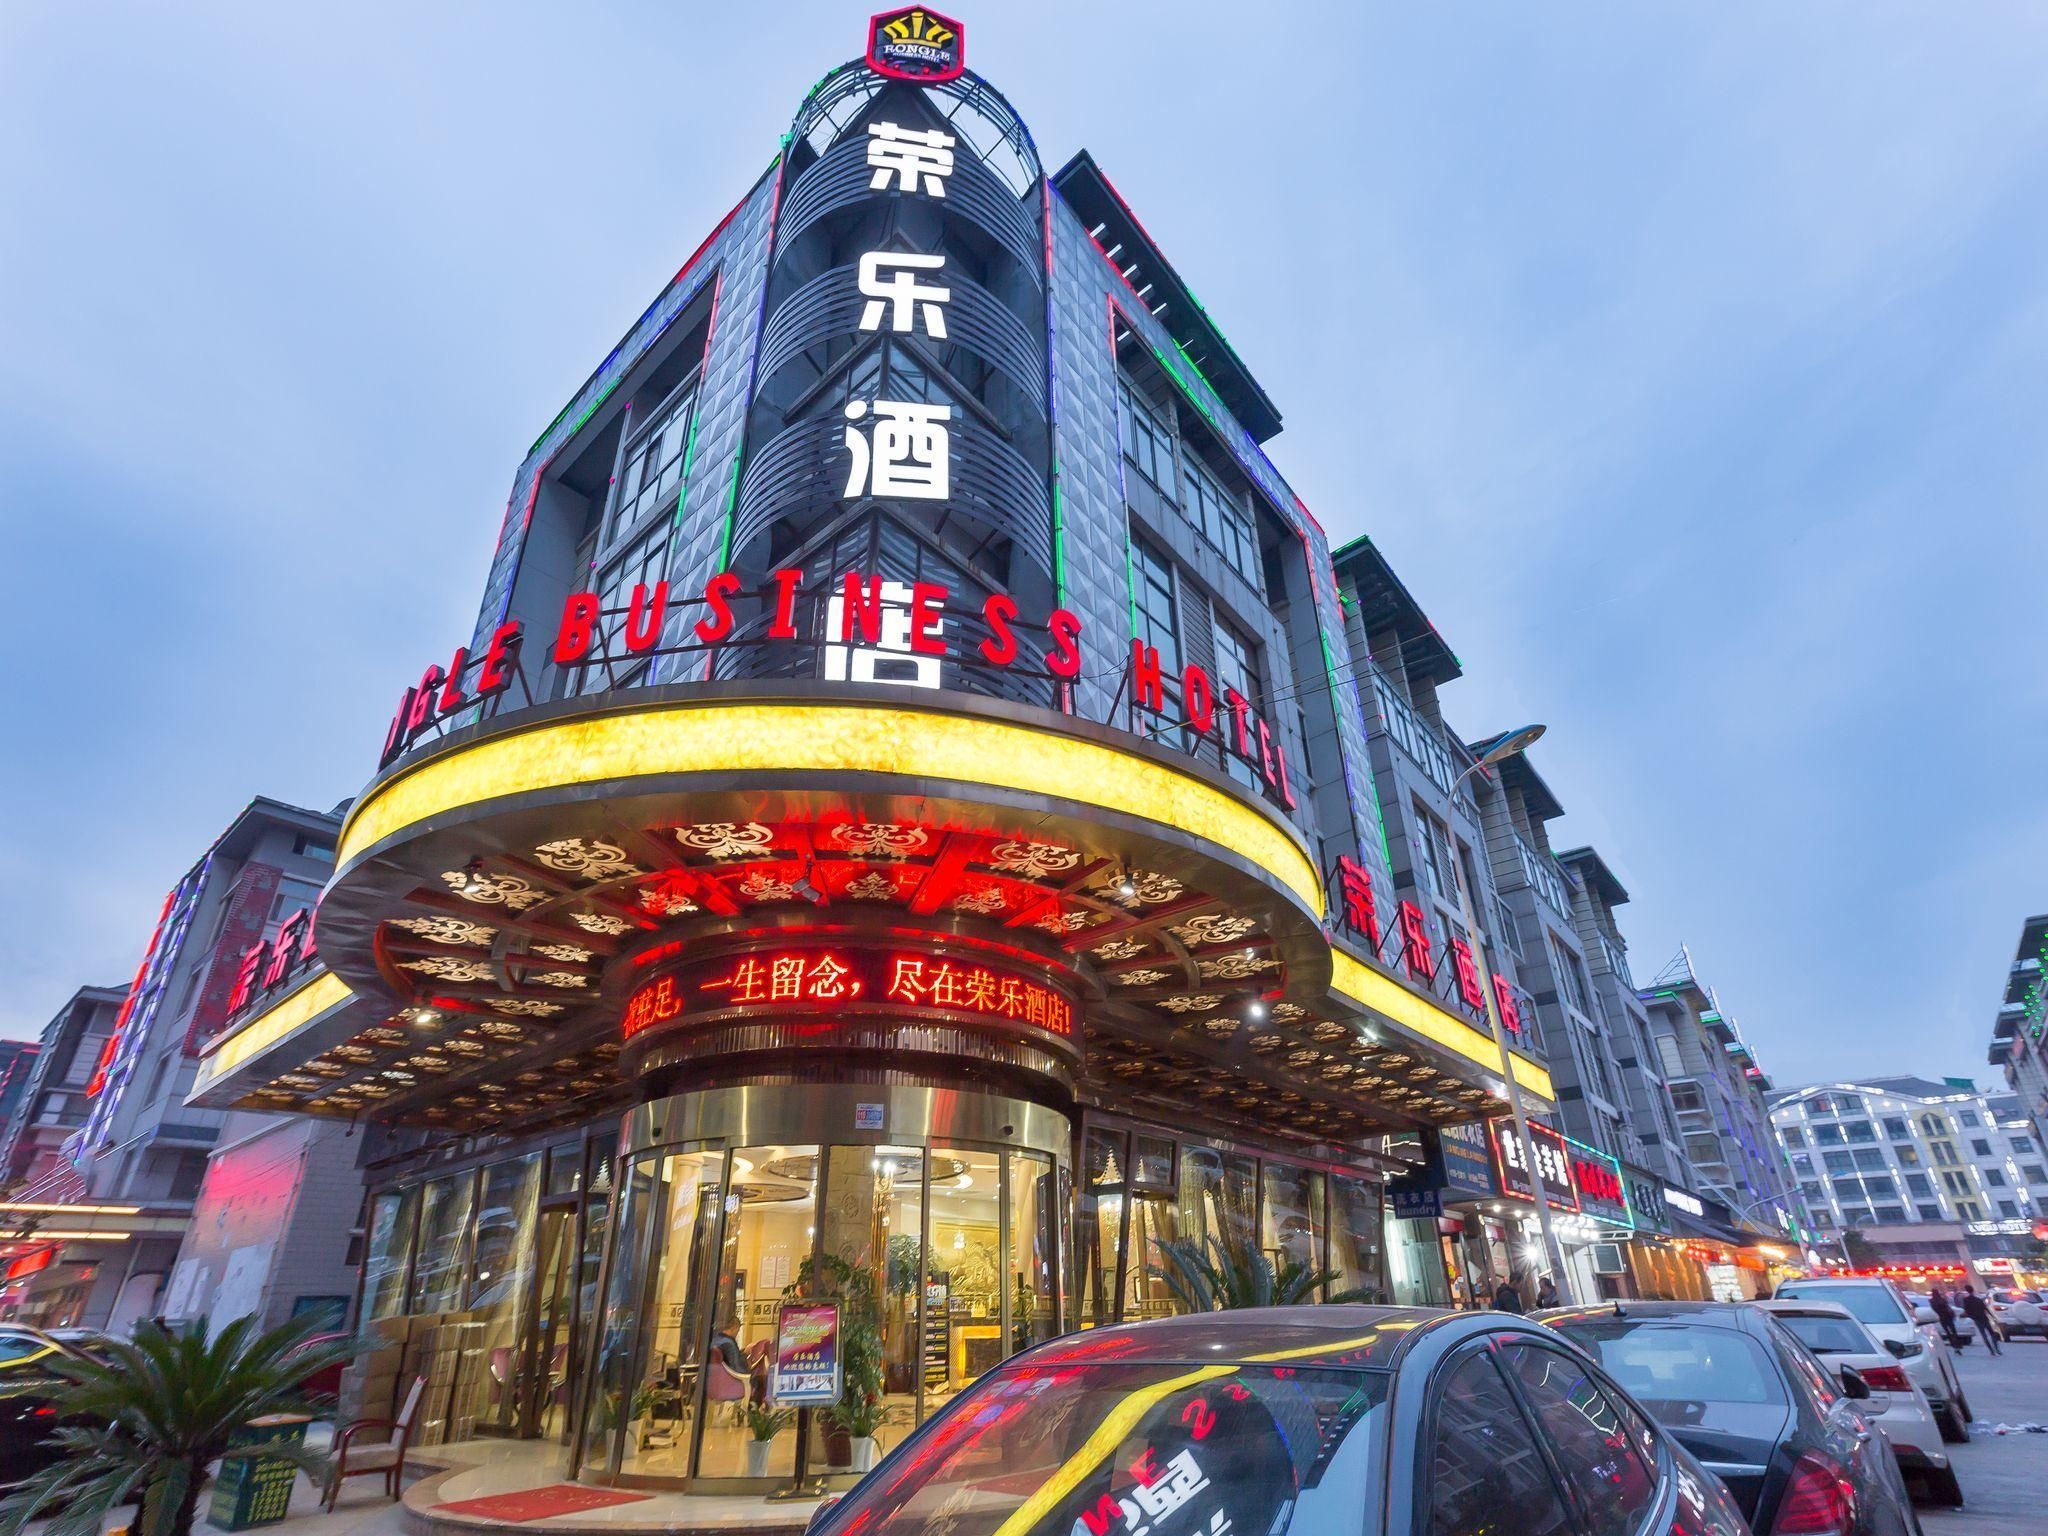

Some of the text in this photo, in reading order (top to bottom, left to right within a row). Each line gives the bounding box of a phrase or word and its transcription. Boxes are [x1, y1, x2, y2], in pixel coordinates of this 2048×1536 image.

[554, 569, 1083, 682] BUSINESS
[1131, 638, 1297, 811] HOTEL
[1337, 854, 1521, 1034] 荣乐酒店
